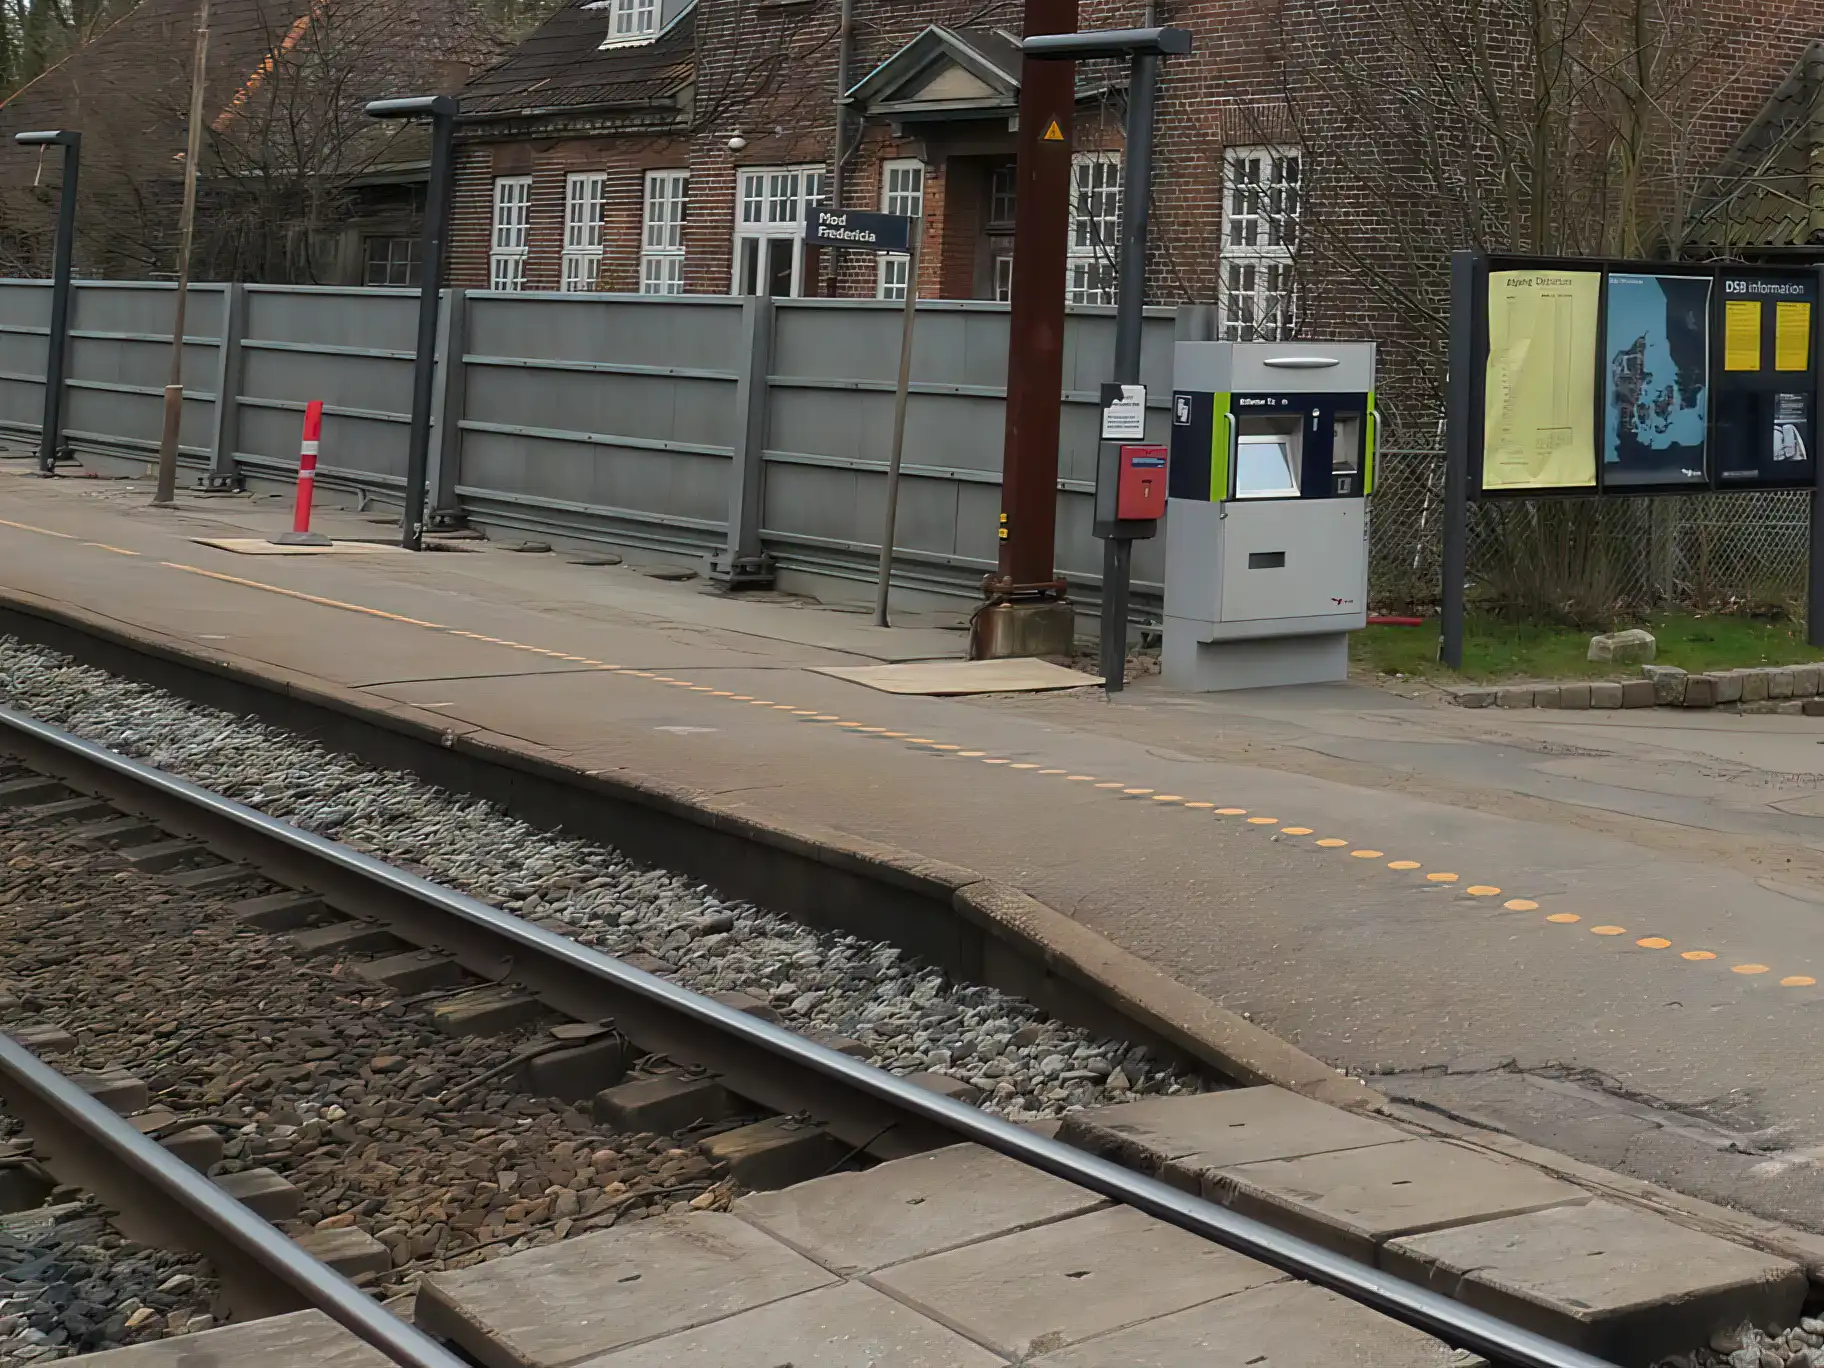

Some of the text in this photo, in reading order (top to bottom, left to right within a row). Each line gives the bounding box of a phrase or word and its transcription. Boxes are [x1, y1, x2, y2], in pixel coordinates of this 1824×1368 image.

[818, 212, 847, 226] Mod
[817, 225, 877, 242] Fredericia
[1725, 280, 1805, 294] DSB information
